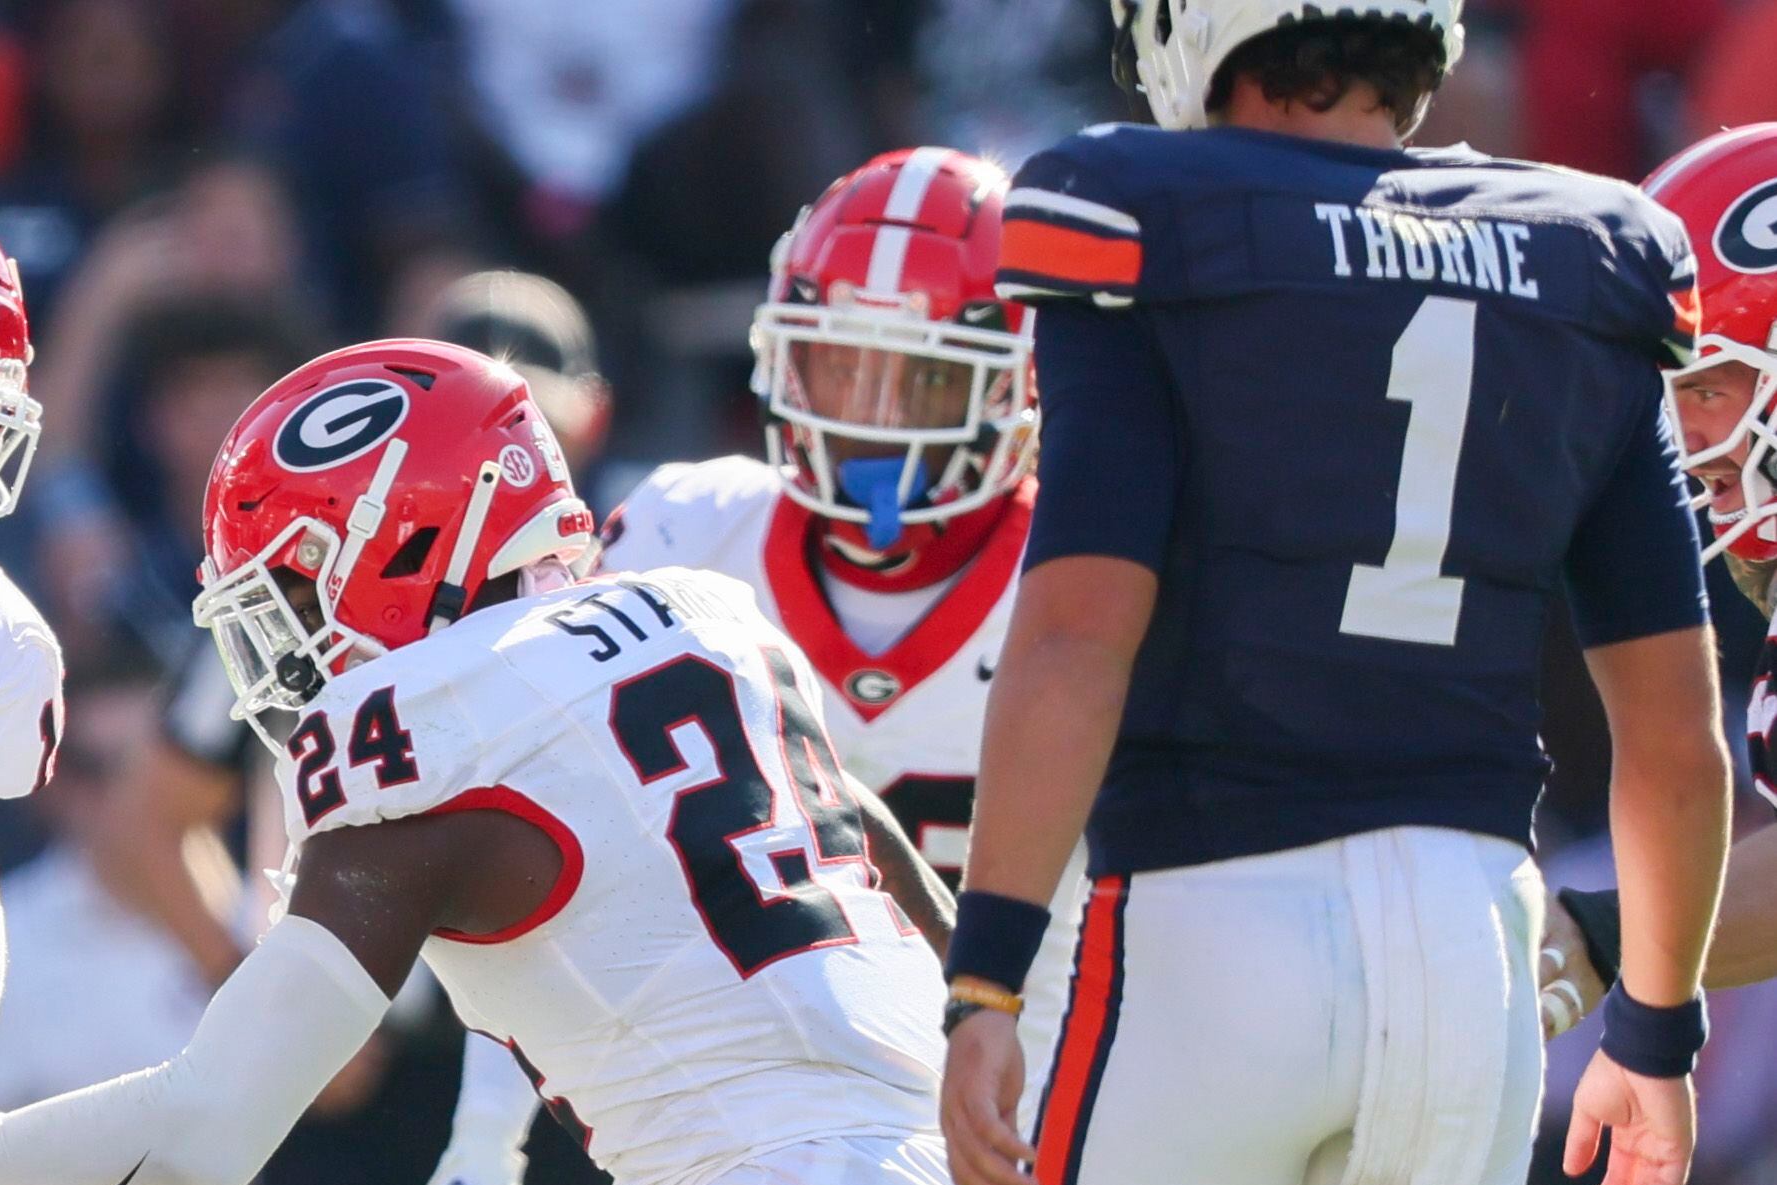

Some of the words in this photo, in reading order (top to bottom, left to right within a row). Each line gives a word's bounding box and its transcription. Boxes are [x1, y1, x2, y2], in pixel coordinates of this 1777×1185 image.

[1314, 203, 1539, 300] THORNE
[283, 383, 406, 464] G
[501, 447, 533, 485] SEC
[1339, 296, 1477, 647] 1
[286, 684, 421, 830] 24
[607, 645, 921, 981] 24
